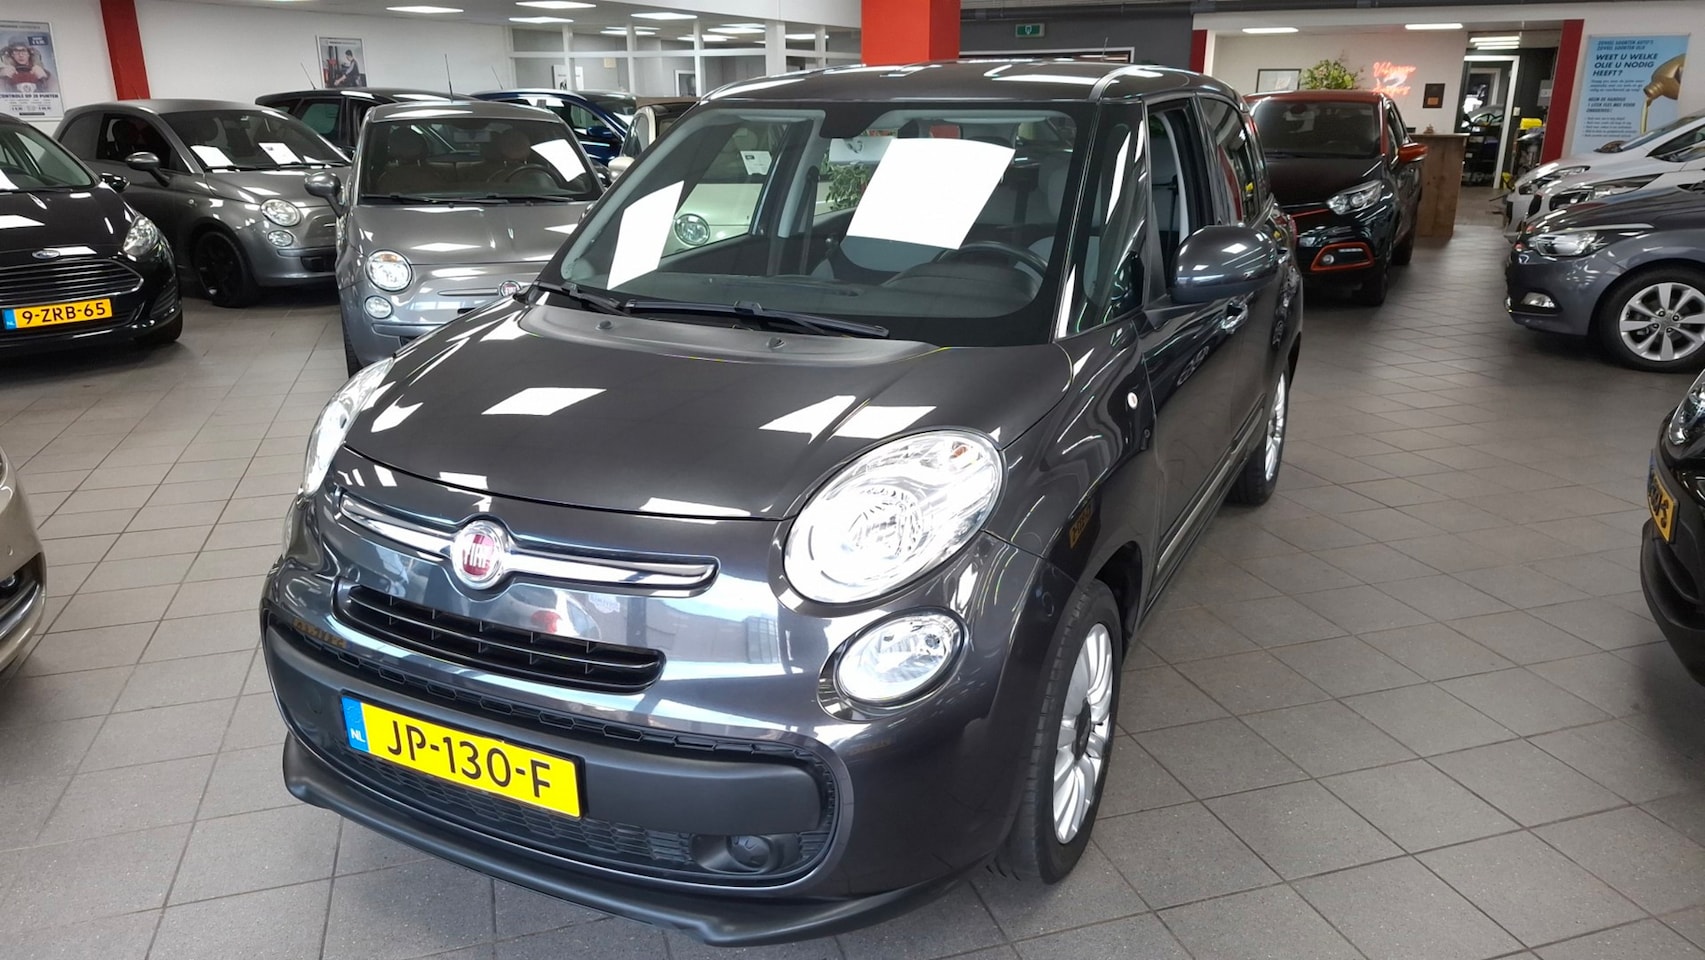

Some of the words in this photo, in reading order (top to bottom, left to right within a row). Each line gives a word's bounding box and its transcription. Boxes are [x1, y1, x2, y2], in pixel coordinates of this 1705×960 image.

[22, 302, 105, 325] 9-ZRB-65
[350, 727, 366, 743] NL
[387, 720, 550, 798] JP-130-F
